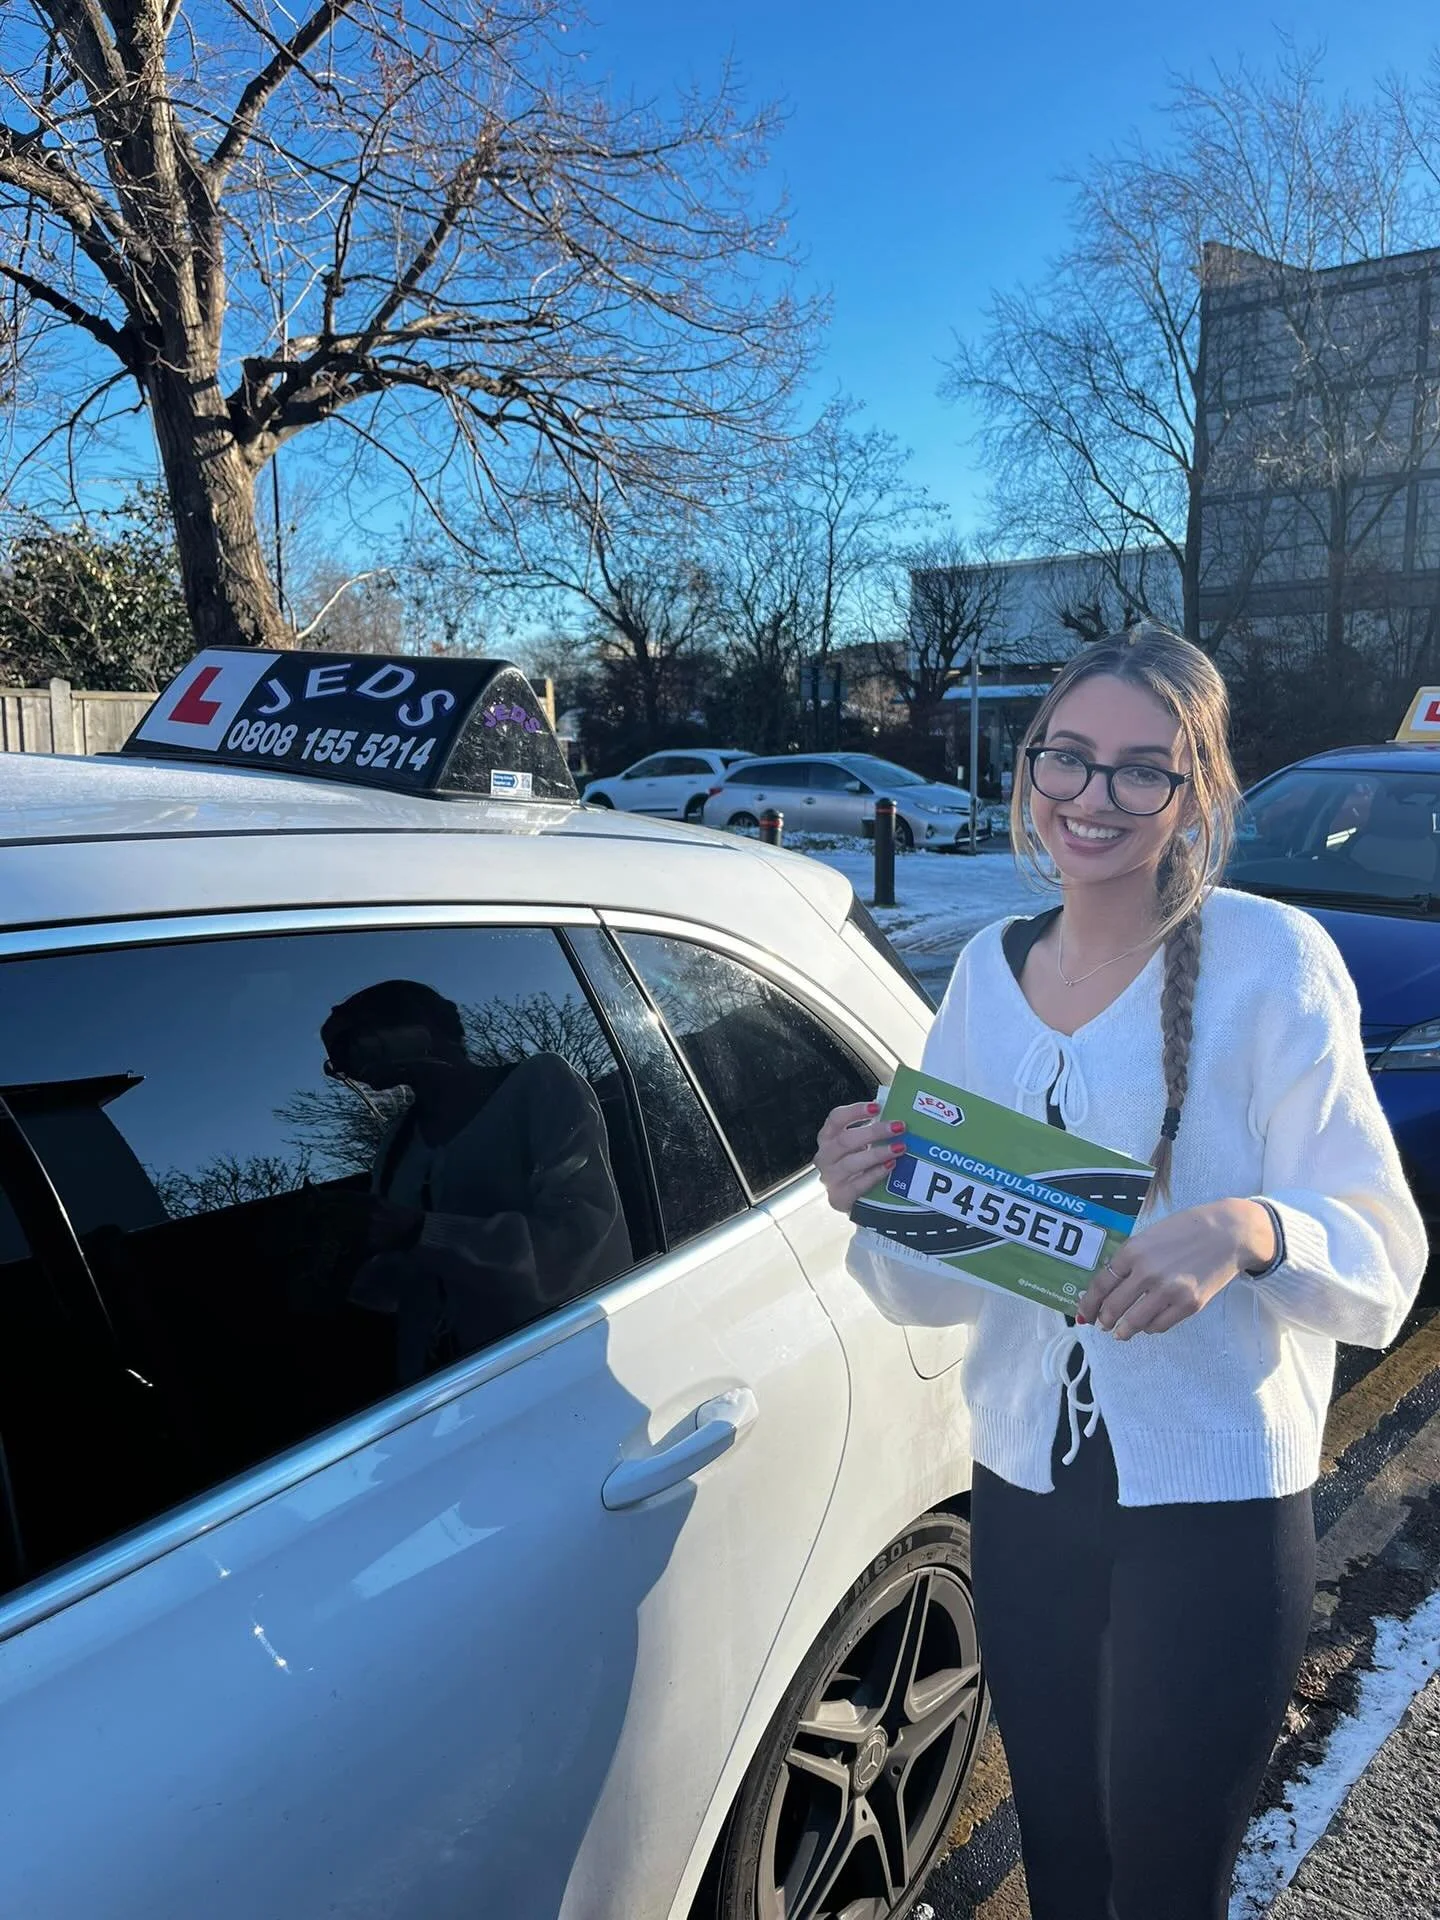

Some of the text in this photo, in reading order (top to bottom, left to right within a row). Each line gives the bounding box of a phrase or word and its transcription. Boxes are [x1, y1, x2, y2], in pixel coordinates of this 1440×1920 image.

[169, 667, 222, 725] L
[257, 663, 456, 728] JEDS
[482, 704, 541, 733] JEDS
[227, 720, 436, 772] 0808 155 5214
[918, 1097, 954, 1117] JEDS
[893, 1180, 907, 1190] GB
[929, 1146, 1086, 1213] CONGRATULATIONS
